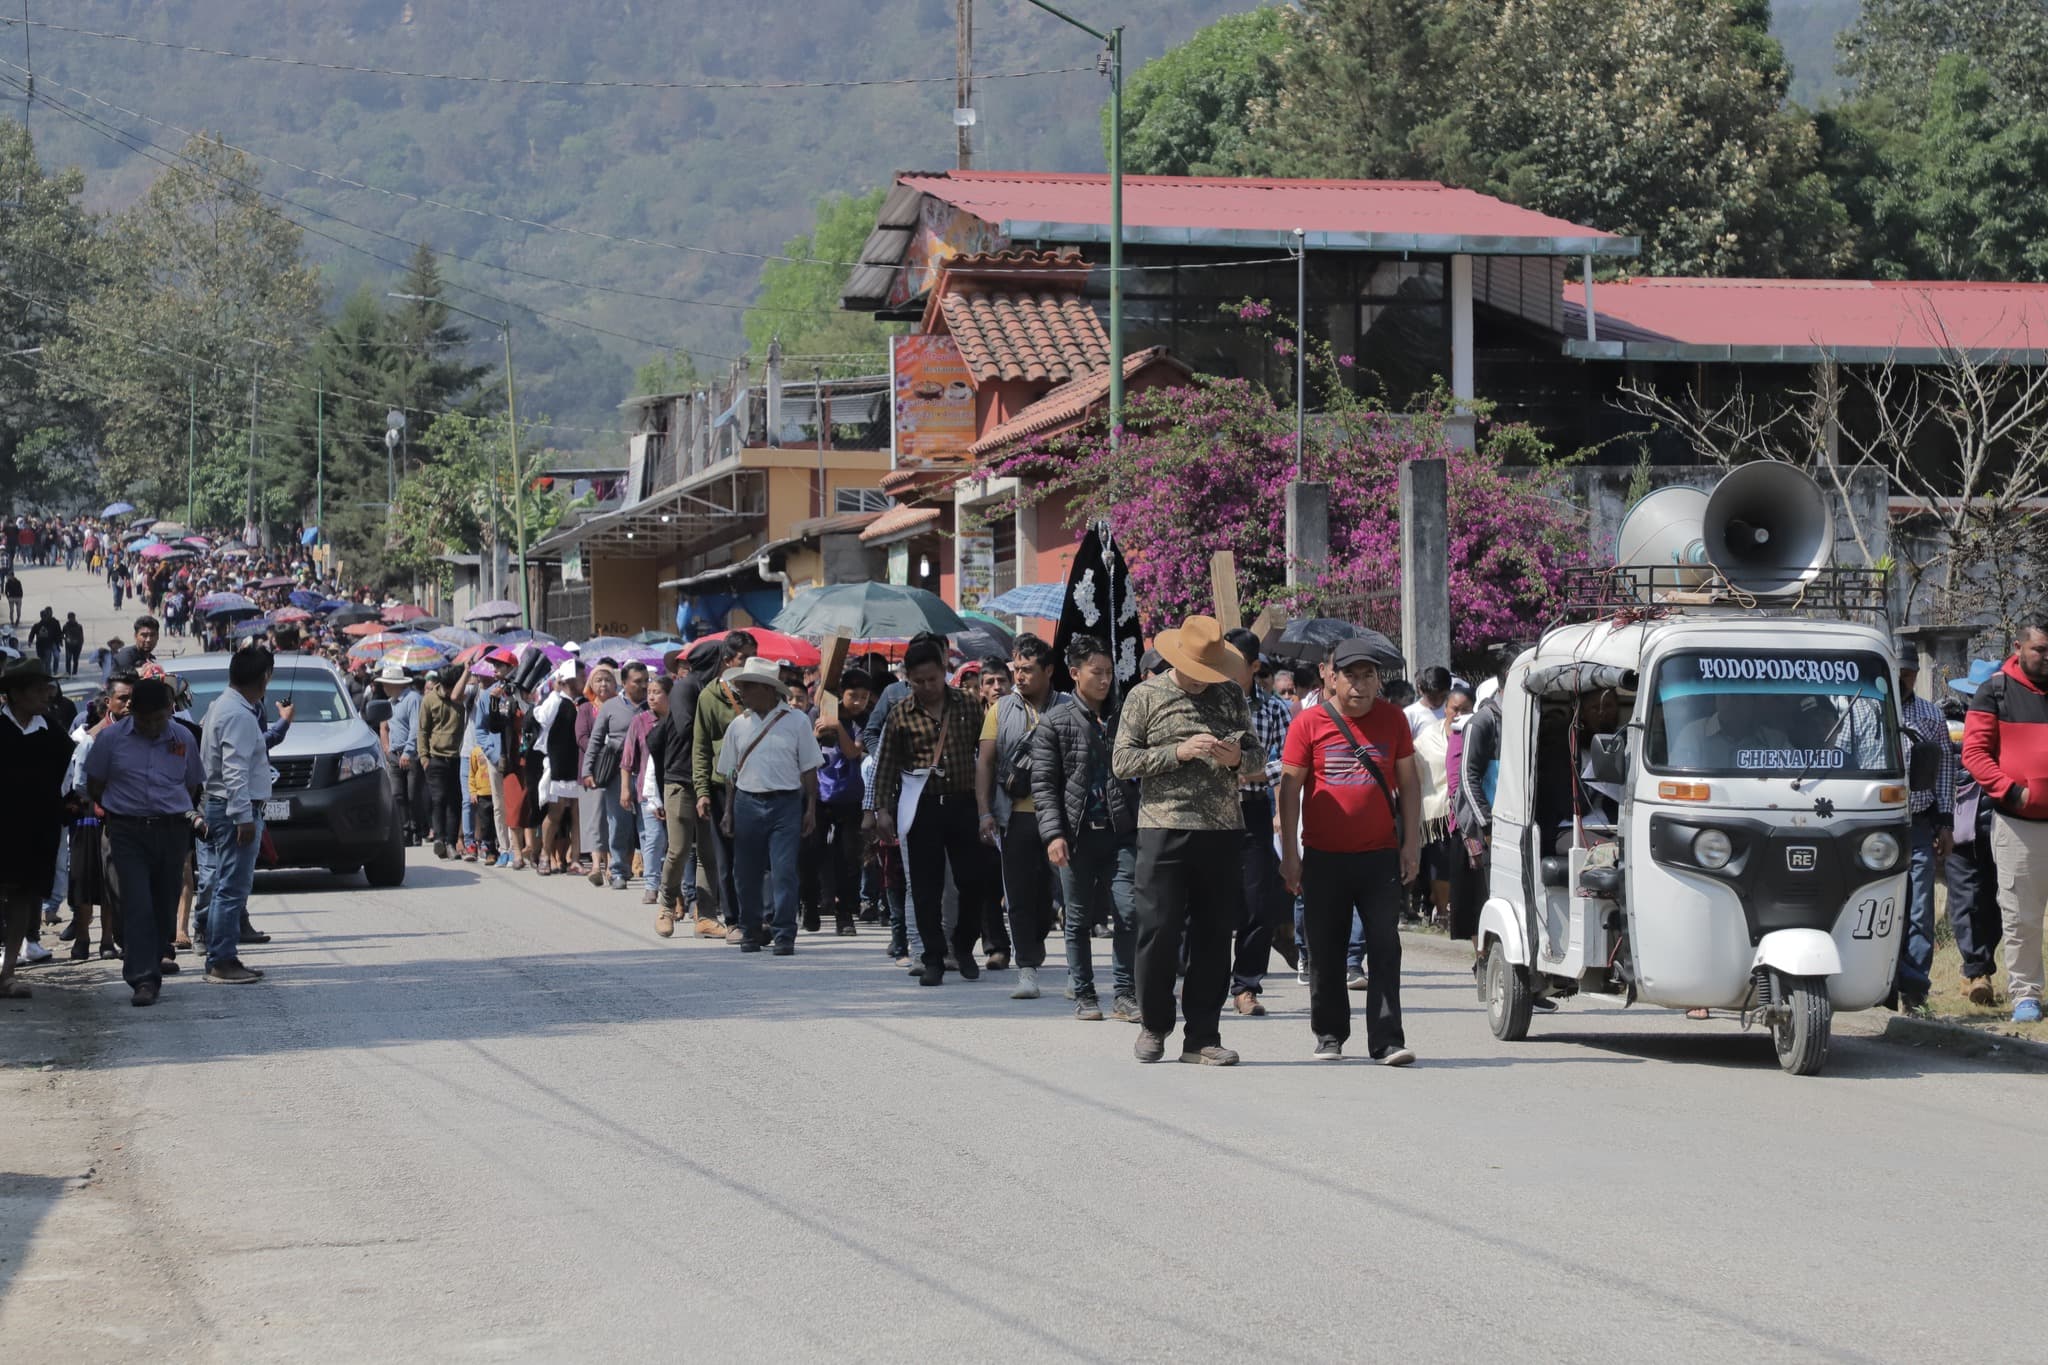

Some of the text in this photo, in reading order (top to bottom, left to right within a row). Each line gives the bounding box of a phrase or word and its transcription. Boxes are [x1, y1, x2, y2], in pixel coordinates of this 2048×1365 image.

[1700, 658, 1859, 684] TODOPODEROSO
[1736, 749, 1844, 769] CHENALHO
[1792, 854, 1812, 866] RE
[1852, 897, 1895, 940] 19
